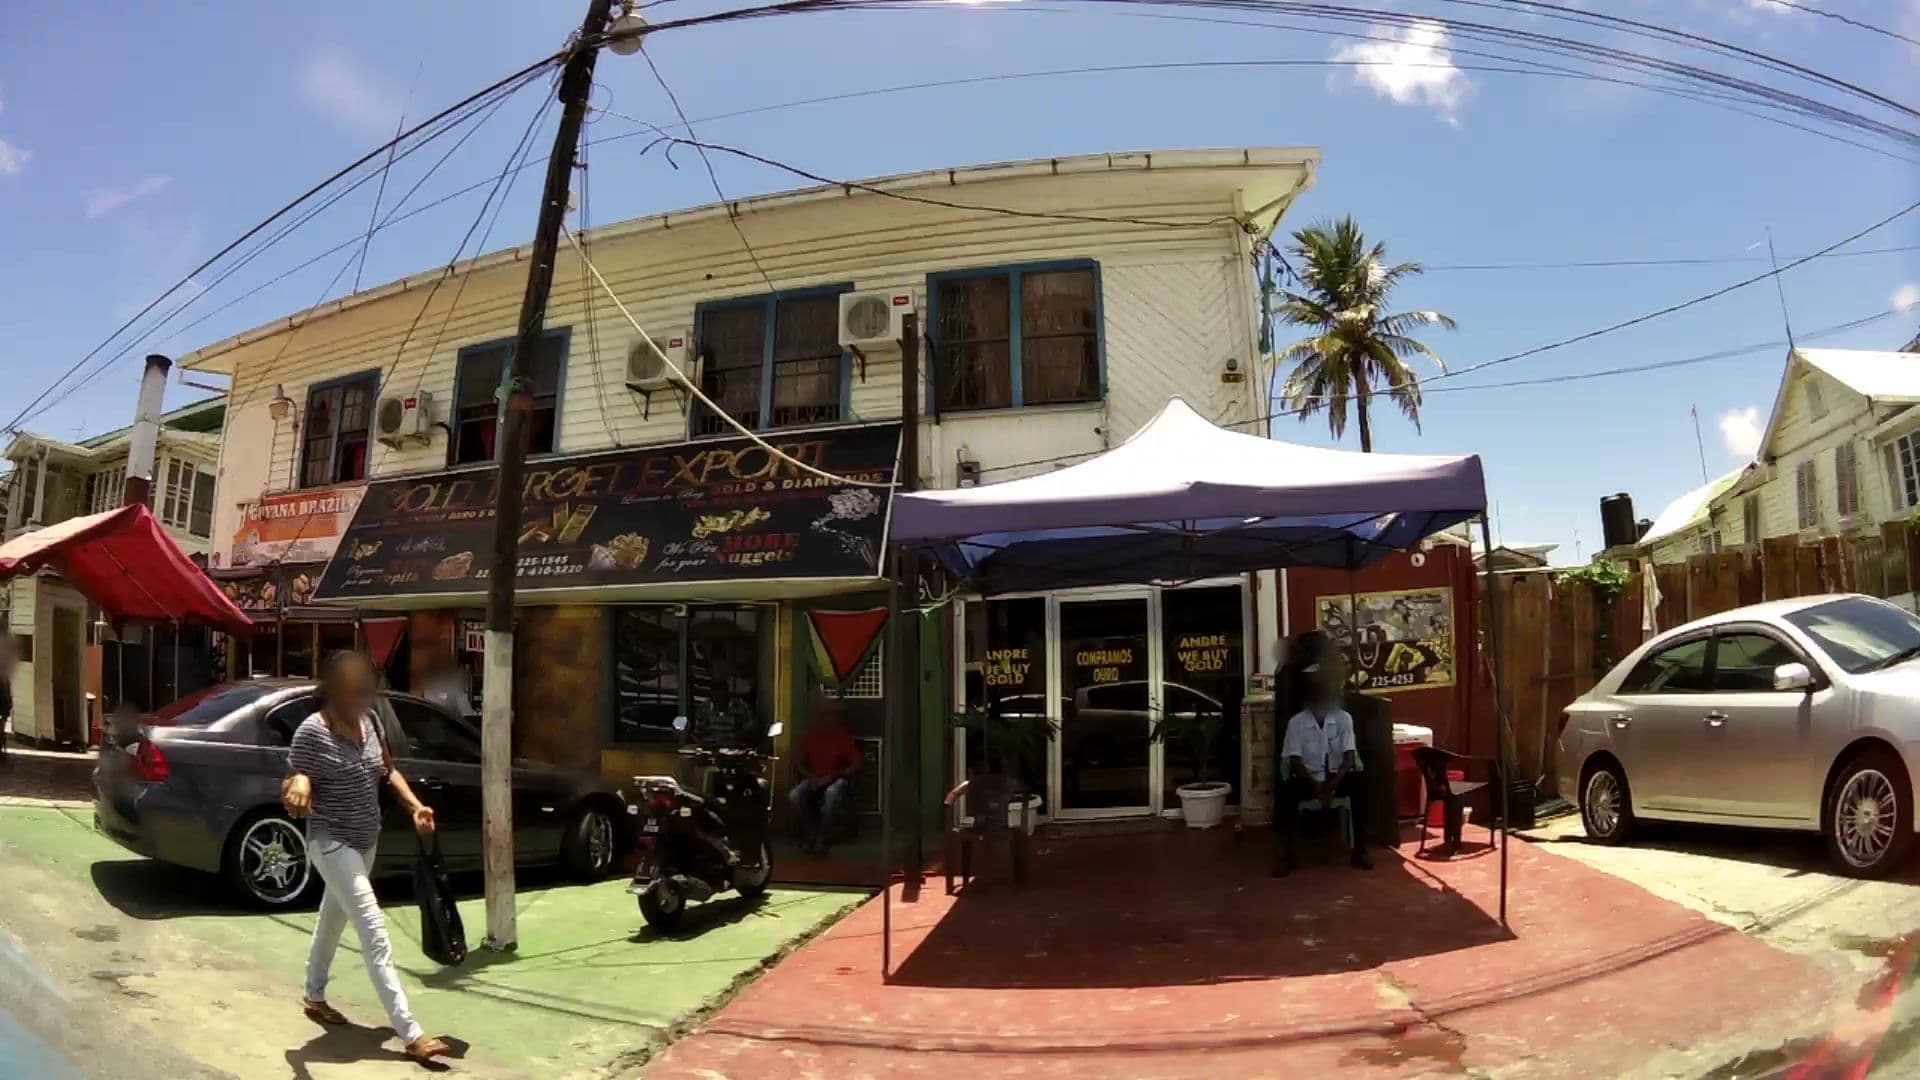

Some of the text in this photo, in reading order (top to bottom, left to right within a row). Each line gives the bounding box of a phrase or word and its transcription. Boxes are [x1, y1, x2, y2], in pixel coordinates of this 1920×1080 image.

[636, 439, 830, 492] EXPORT
[1076, 648, 1134, 666] COMPRAMOS
[1177, 648, 1229, 663] WE BUY
[1185, 660, 1223, 672] GOLD
[985, 672, 1025, 685] GOLD
